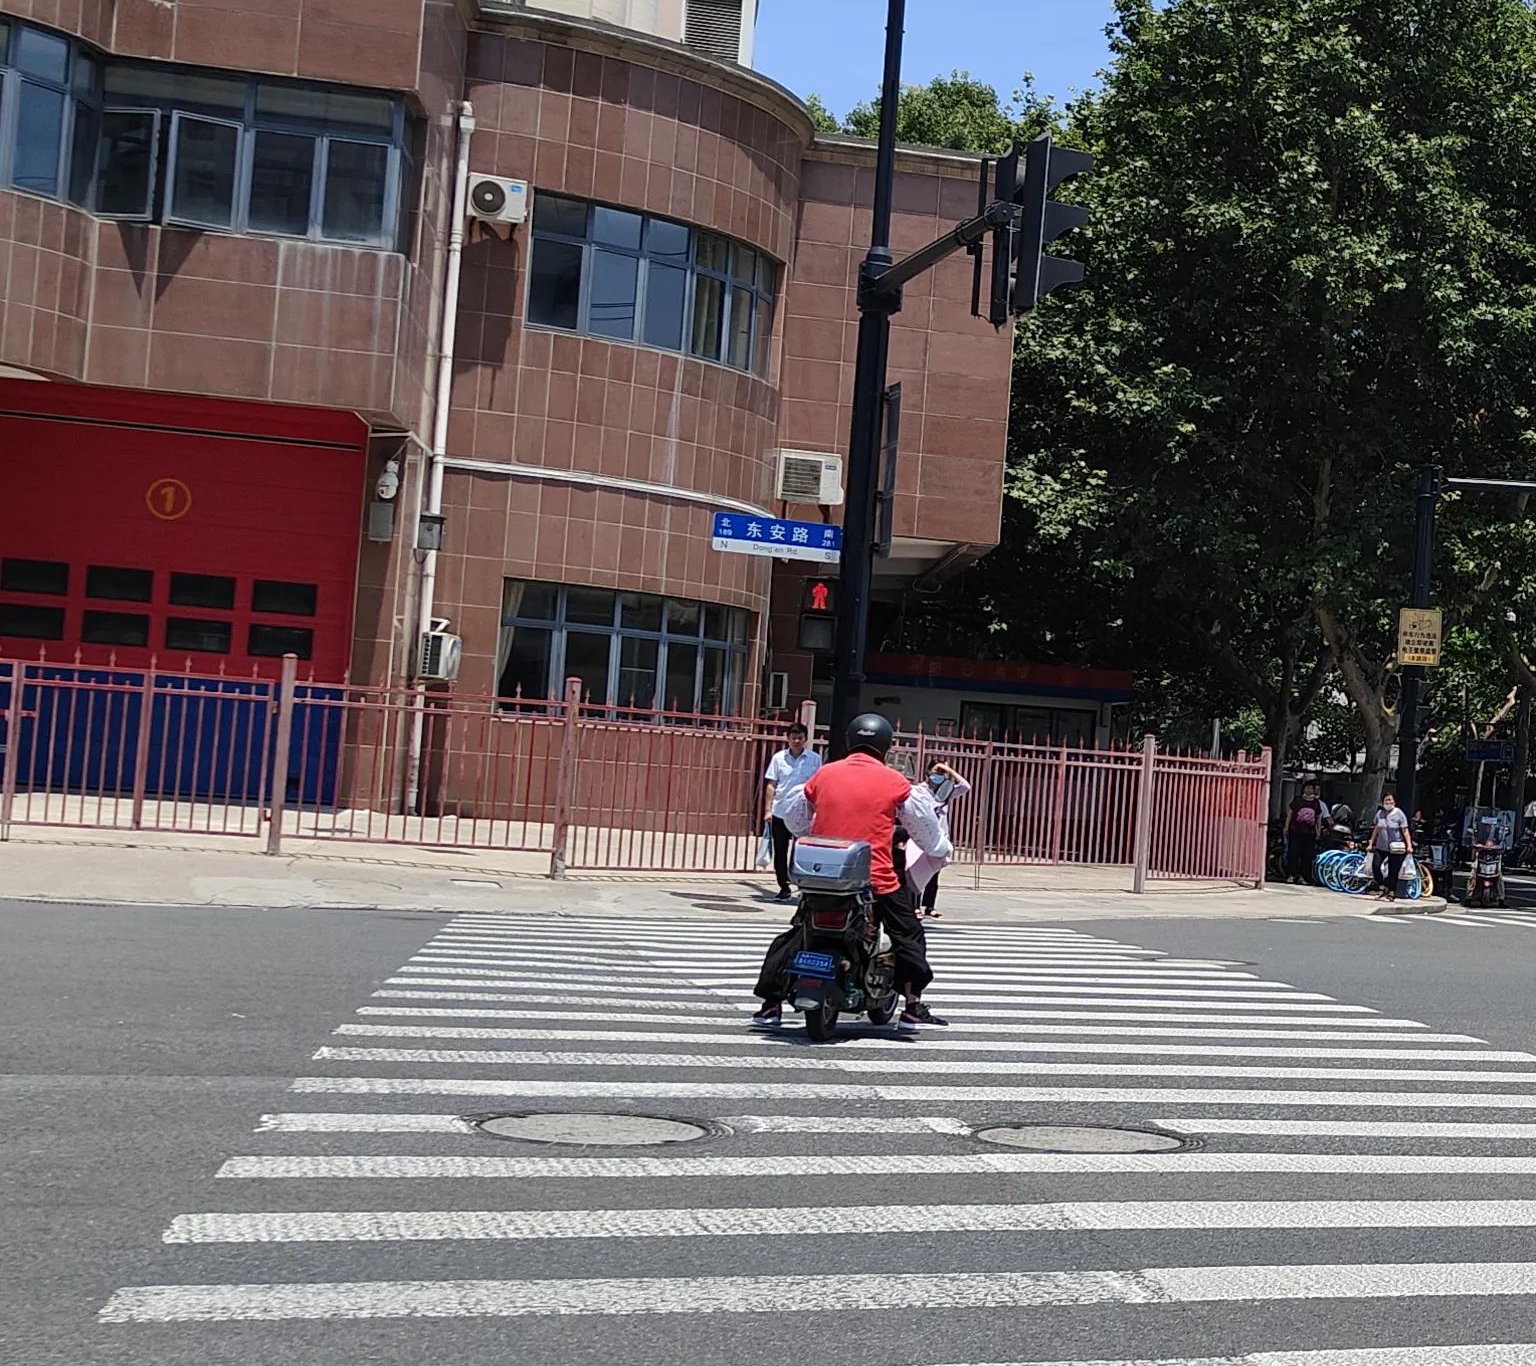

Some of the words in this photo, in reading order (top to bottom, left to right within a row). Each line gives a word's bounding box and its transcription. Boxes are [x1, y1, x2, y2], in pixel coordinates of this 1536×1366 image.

[720, 517, 732, 528] 北
[746, 521, 809, 543] 东安路
[823, 528, 834, 539] 南
[720, 541, 728, 549] N
[824, 552, 832, 560] S
